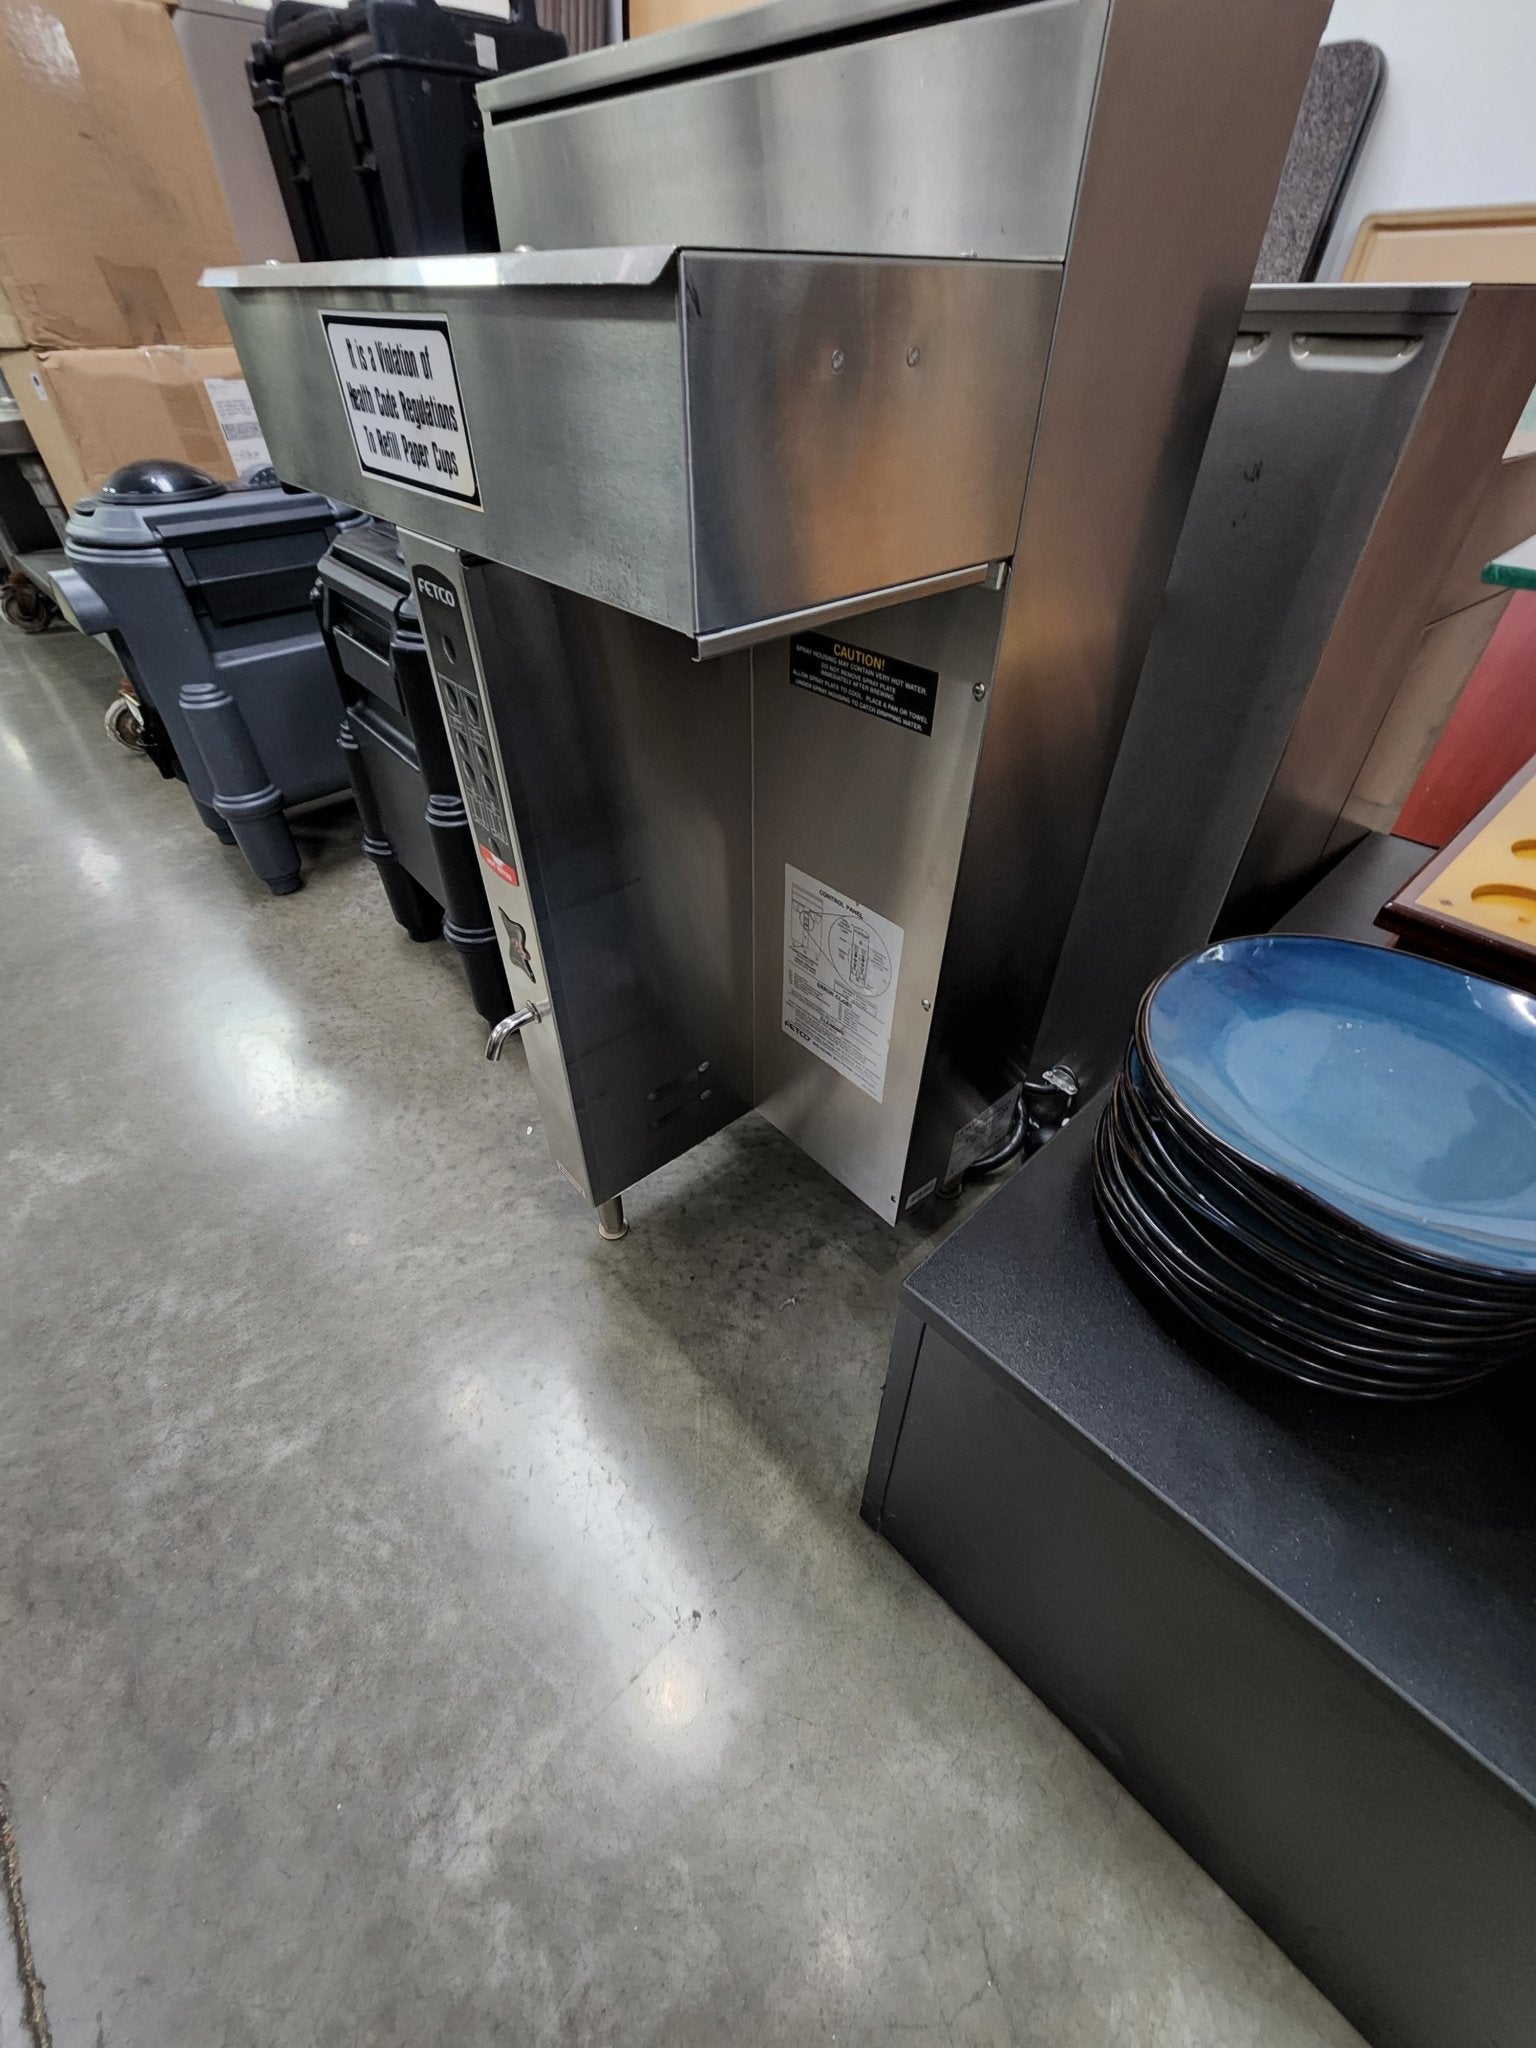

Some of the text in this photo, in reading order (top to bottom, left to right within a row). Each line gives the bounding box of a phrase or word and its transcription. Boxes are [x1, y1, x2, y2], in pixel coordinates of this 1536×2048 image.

[345, 337, 433, 380] It is a Violation of
[346, 381, 459, 433] Health Code Regulations
[363, 425, 459, 480] To Refill Paper Cups
[417, 577, 456, 608] FETCO
[796, 644, 812, 655] SPRAY
[812, 650, 838, 664] HOUSING
[838, 659, 849, 668] MAY
[850, 663, 875, 677] CONTAIN
[875, 672, 891, 683] VERY
[891, 677, 904, 687] HOT
[821, 662, 896, 694] DO NOT REMOVE SPRAY PLATE
[833, 643, 885, 671] CAUTION!
[793, 668, 809, 679] ALLOW
[809, 674, 824, 685] SPRAY
[824, 680, 839, 691] PLATE
[840, 685, 848, 693] TO
[865, 695, 882, 707] PLACE
[882, 700, 888, 709] A
[887, 702, 899, 712] PAN
[899, 708, 908, 716] OR
[909, 711, 928, 724] TOWEL
[795, 678, 812, 690] UNDER
[812, 684, 828, 695] SPRAY
[828, 690, 851, 704] HOUSING
[851, 699, 859, 707] TO
[859, 702, 876, 713] CATCH
[876, 708, 902, 723] DRIPPING
[821, 669, 852, 685] IMMEDIATELY
[852, 680, 869, 691] AFTER
[819, 889, 864, 920] CONTROL PANEL
